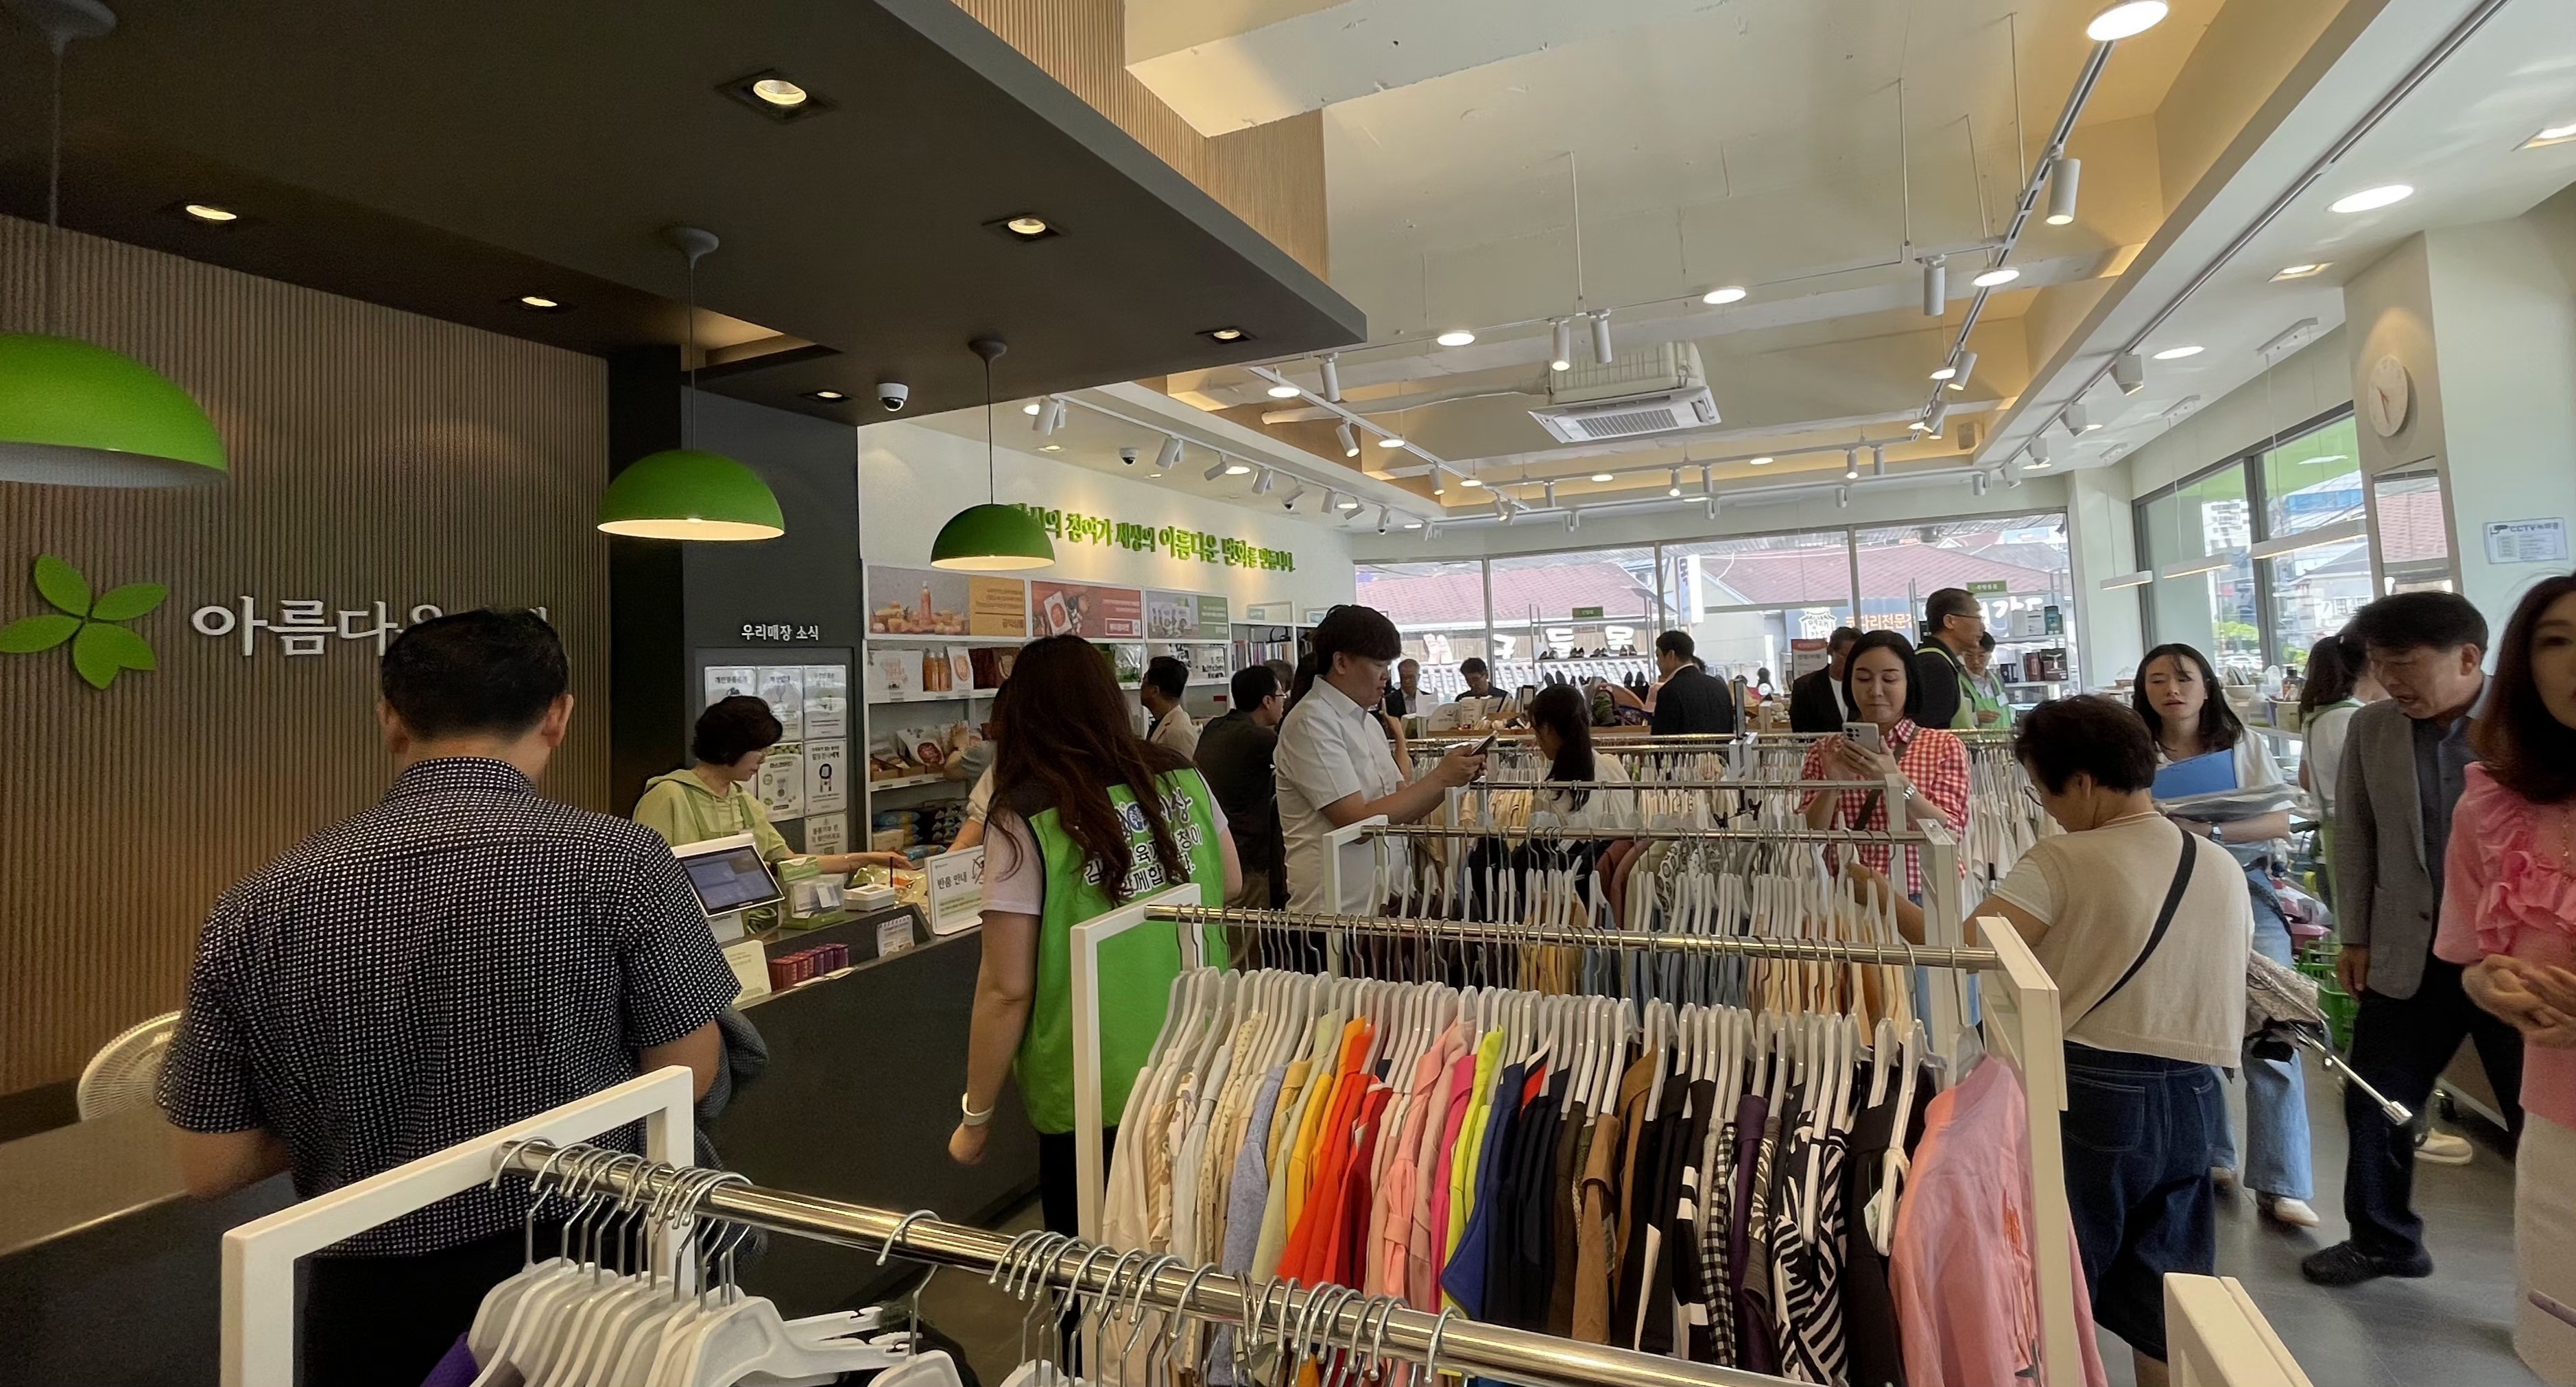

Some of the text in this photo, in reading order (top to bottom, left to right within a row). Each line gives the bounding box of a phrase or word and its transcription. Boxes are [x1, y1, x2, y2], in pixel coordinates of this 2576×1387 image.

[1066, 513, 1113, 547] 참여가
[1159, 525, 1219, 564] 아름다운
[1221, 537, 1258, 568] 변화를
[741, 624, 819, 641] 우리매장 소식
[938, 871, 968, 890] 반품 안내
